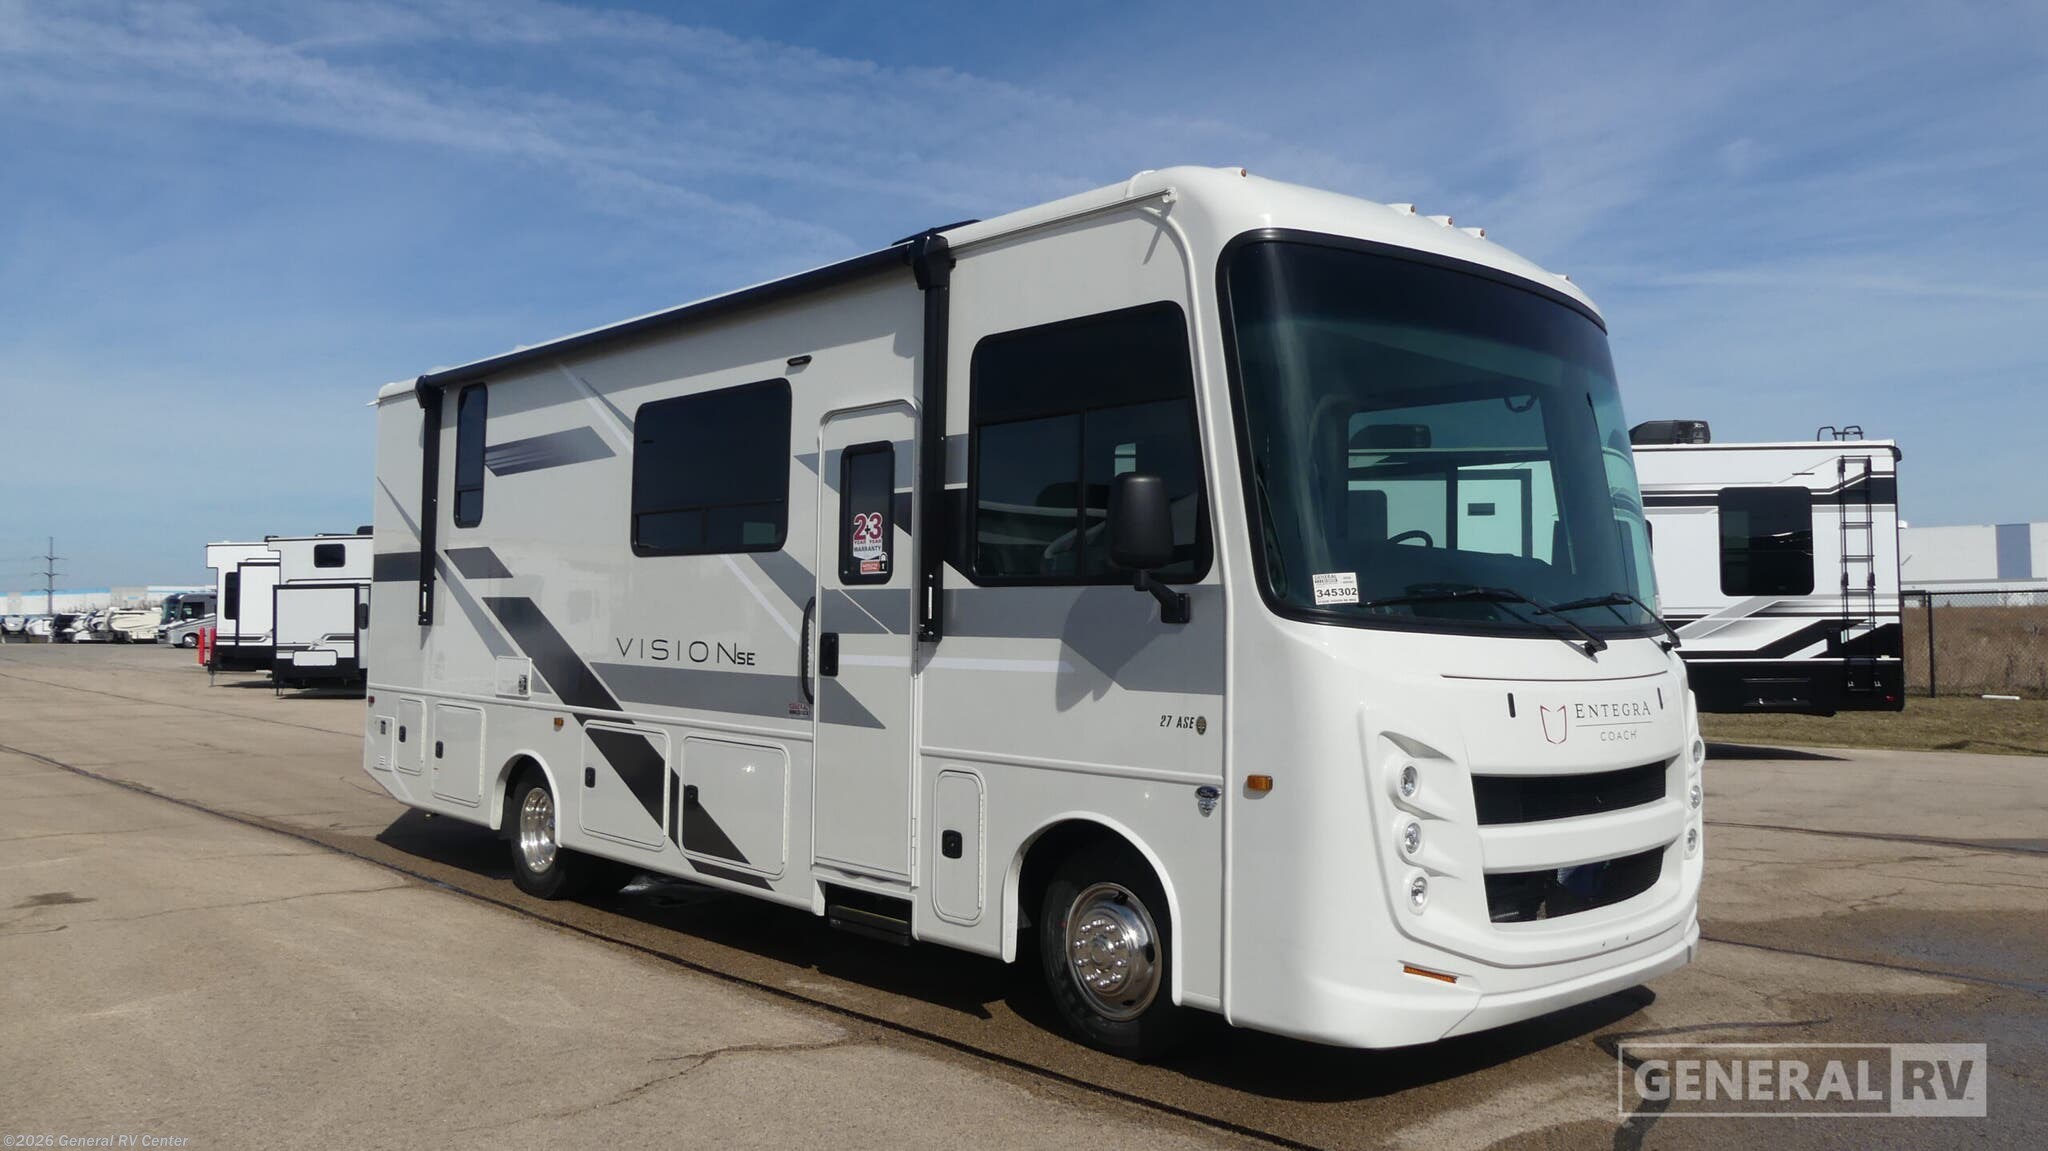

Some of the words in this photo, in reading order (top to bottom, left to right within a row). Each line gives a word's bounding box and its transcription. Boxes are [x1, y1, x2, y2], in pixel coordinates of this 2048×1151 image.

[1316, 587, 1358, 598] 345302
[616, 636, 737, 665] VISION
[736, 651, 756, 667] SE
[1575, 701, 1652, 719] ENTEGRA
[1160, 714, 1173, 728] 27
[1175, 715, 1195, 729] ASE
[1600, 729, 1638, 742] COACH
